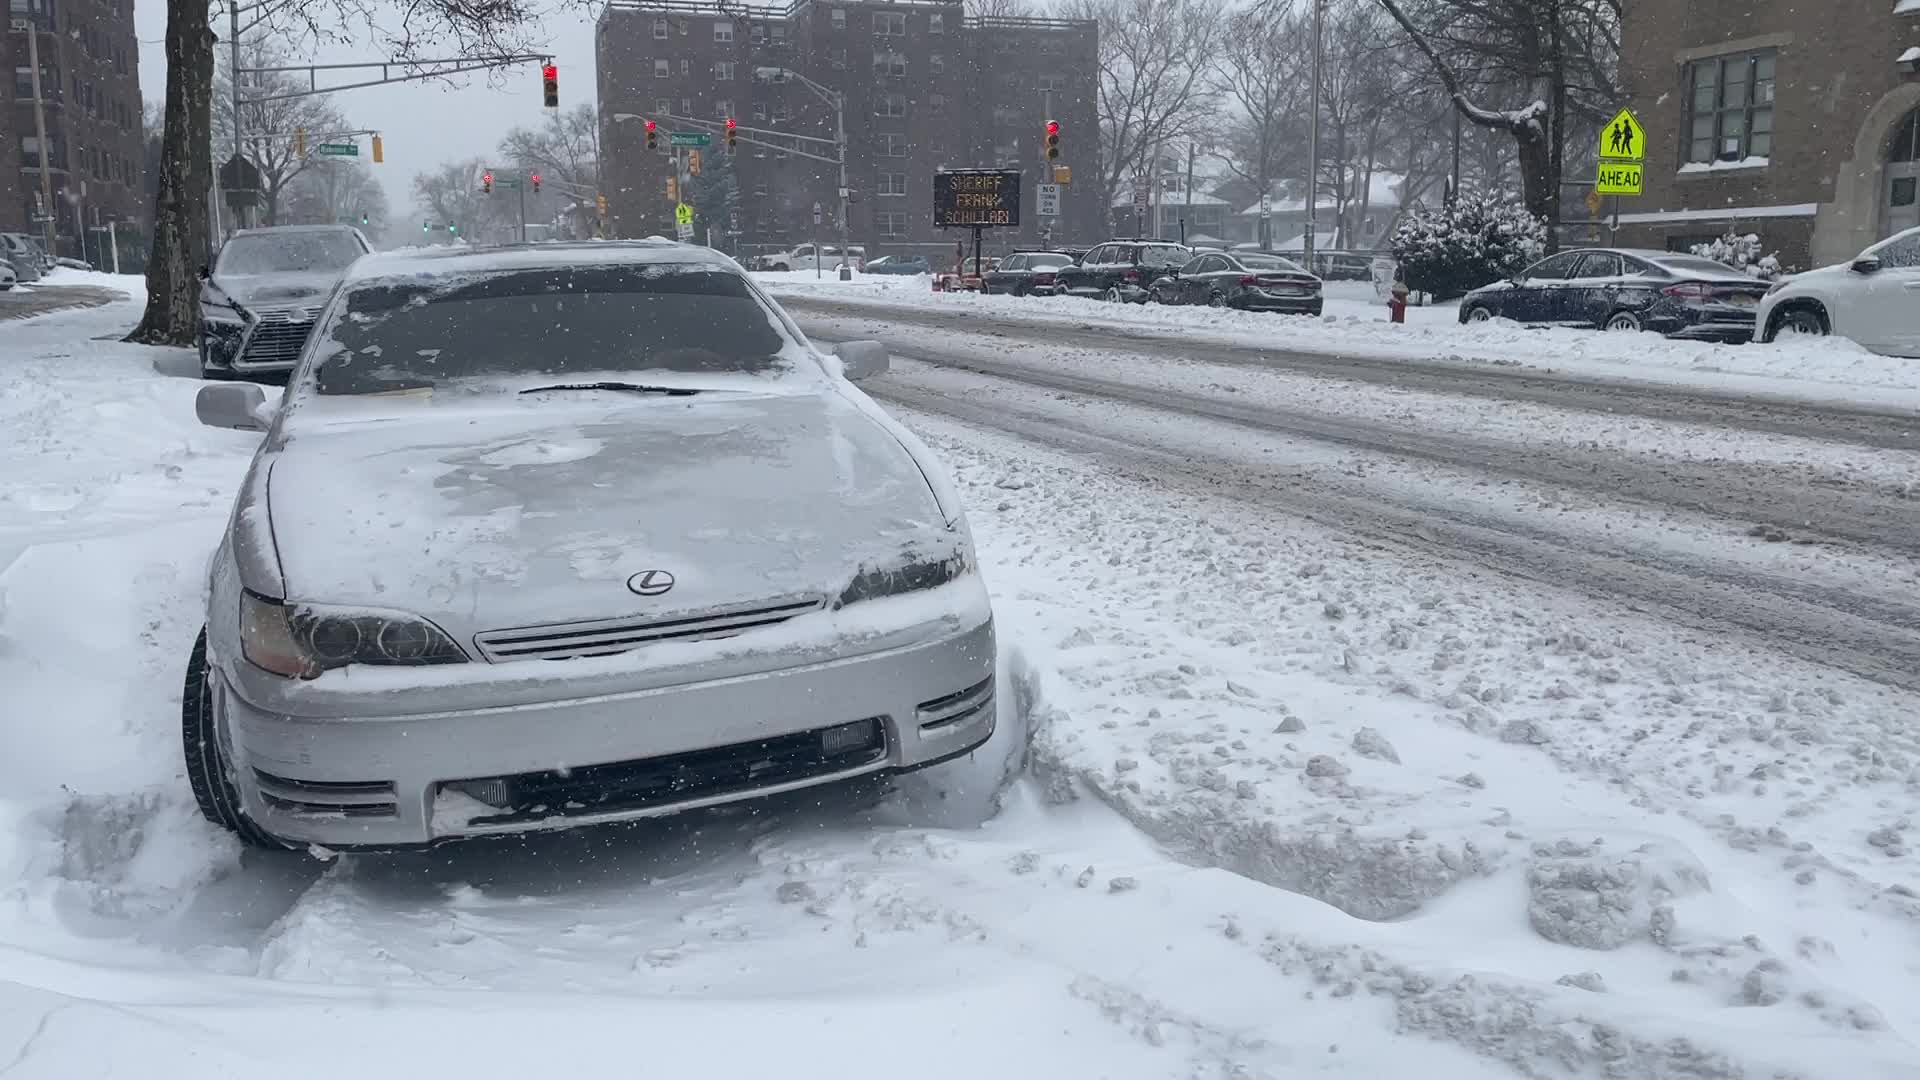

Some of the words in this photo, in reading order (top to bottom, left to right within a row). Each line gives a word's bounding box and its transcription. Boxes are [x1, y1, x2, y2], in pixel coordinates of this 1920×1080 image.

[950, 176, 1003, 190] SHERIFF
[1598, 171, 1640, 185] AHEAD
[956, 193, 1001, 207] FRANK
